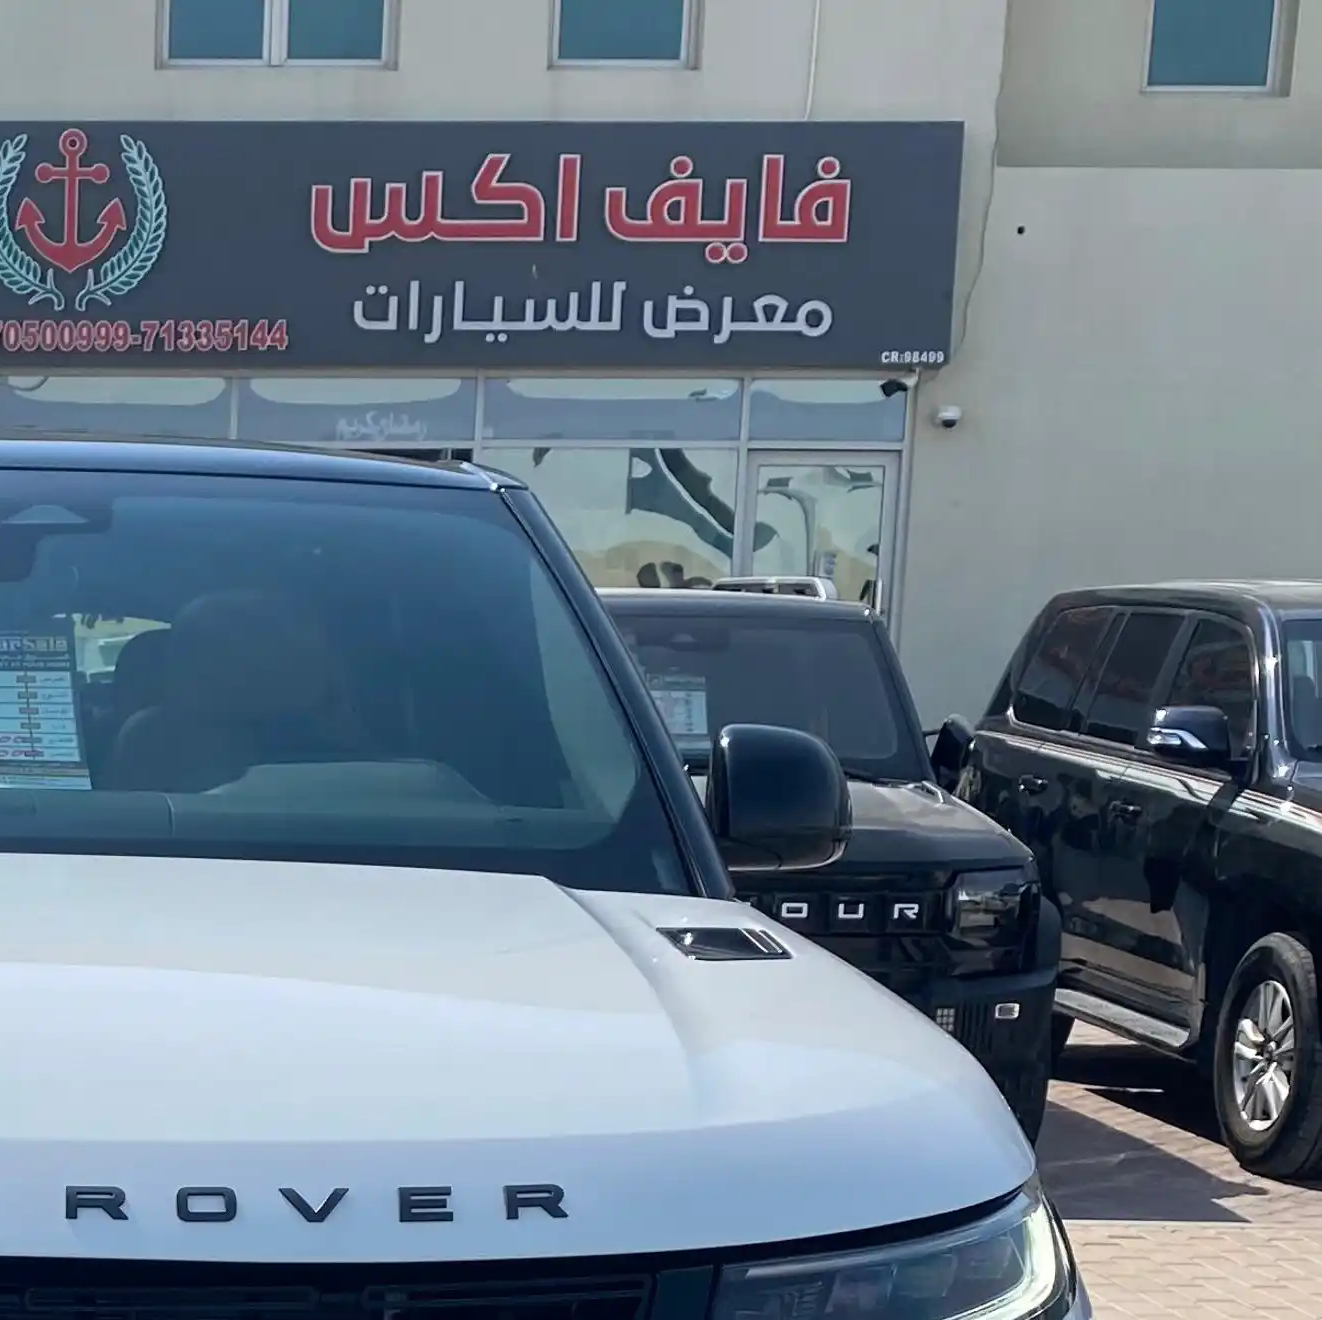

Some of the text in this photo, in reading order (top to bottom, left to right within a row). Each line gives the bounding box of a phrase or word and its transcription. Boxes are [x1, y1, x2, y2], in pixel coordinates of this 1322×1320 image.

[311, 154, 851, 264] فايف اكس
[353, 280, 833, 344] معرض للسيارات
[65, 1184, 570, 1223] ROVER
